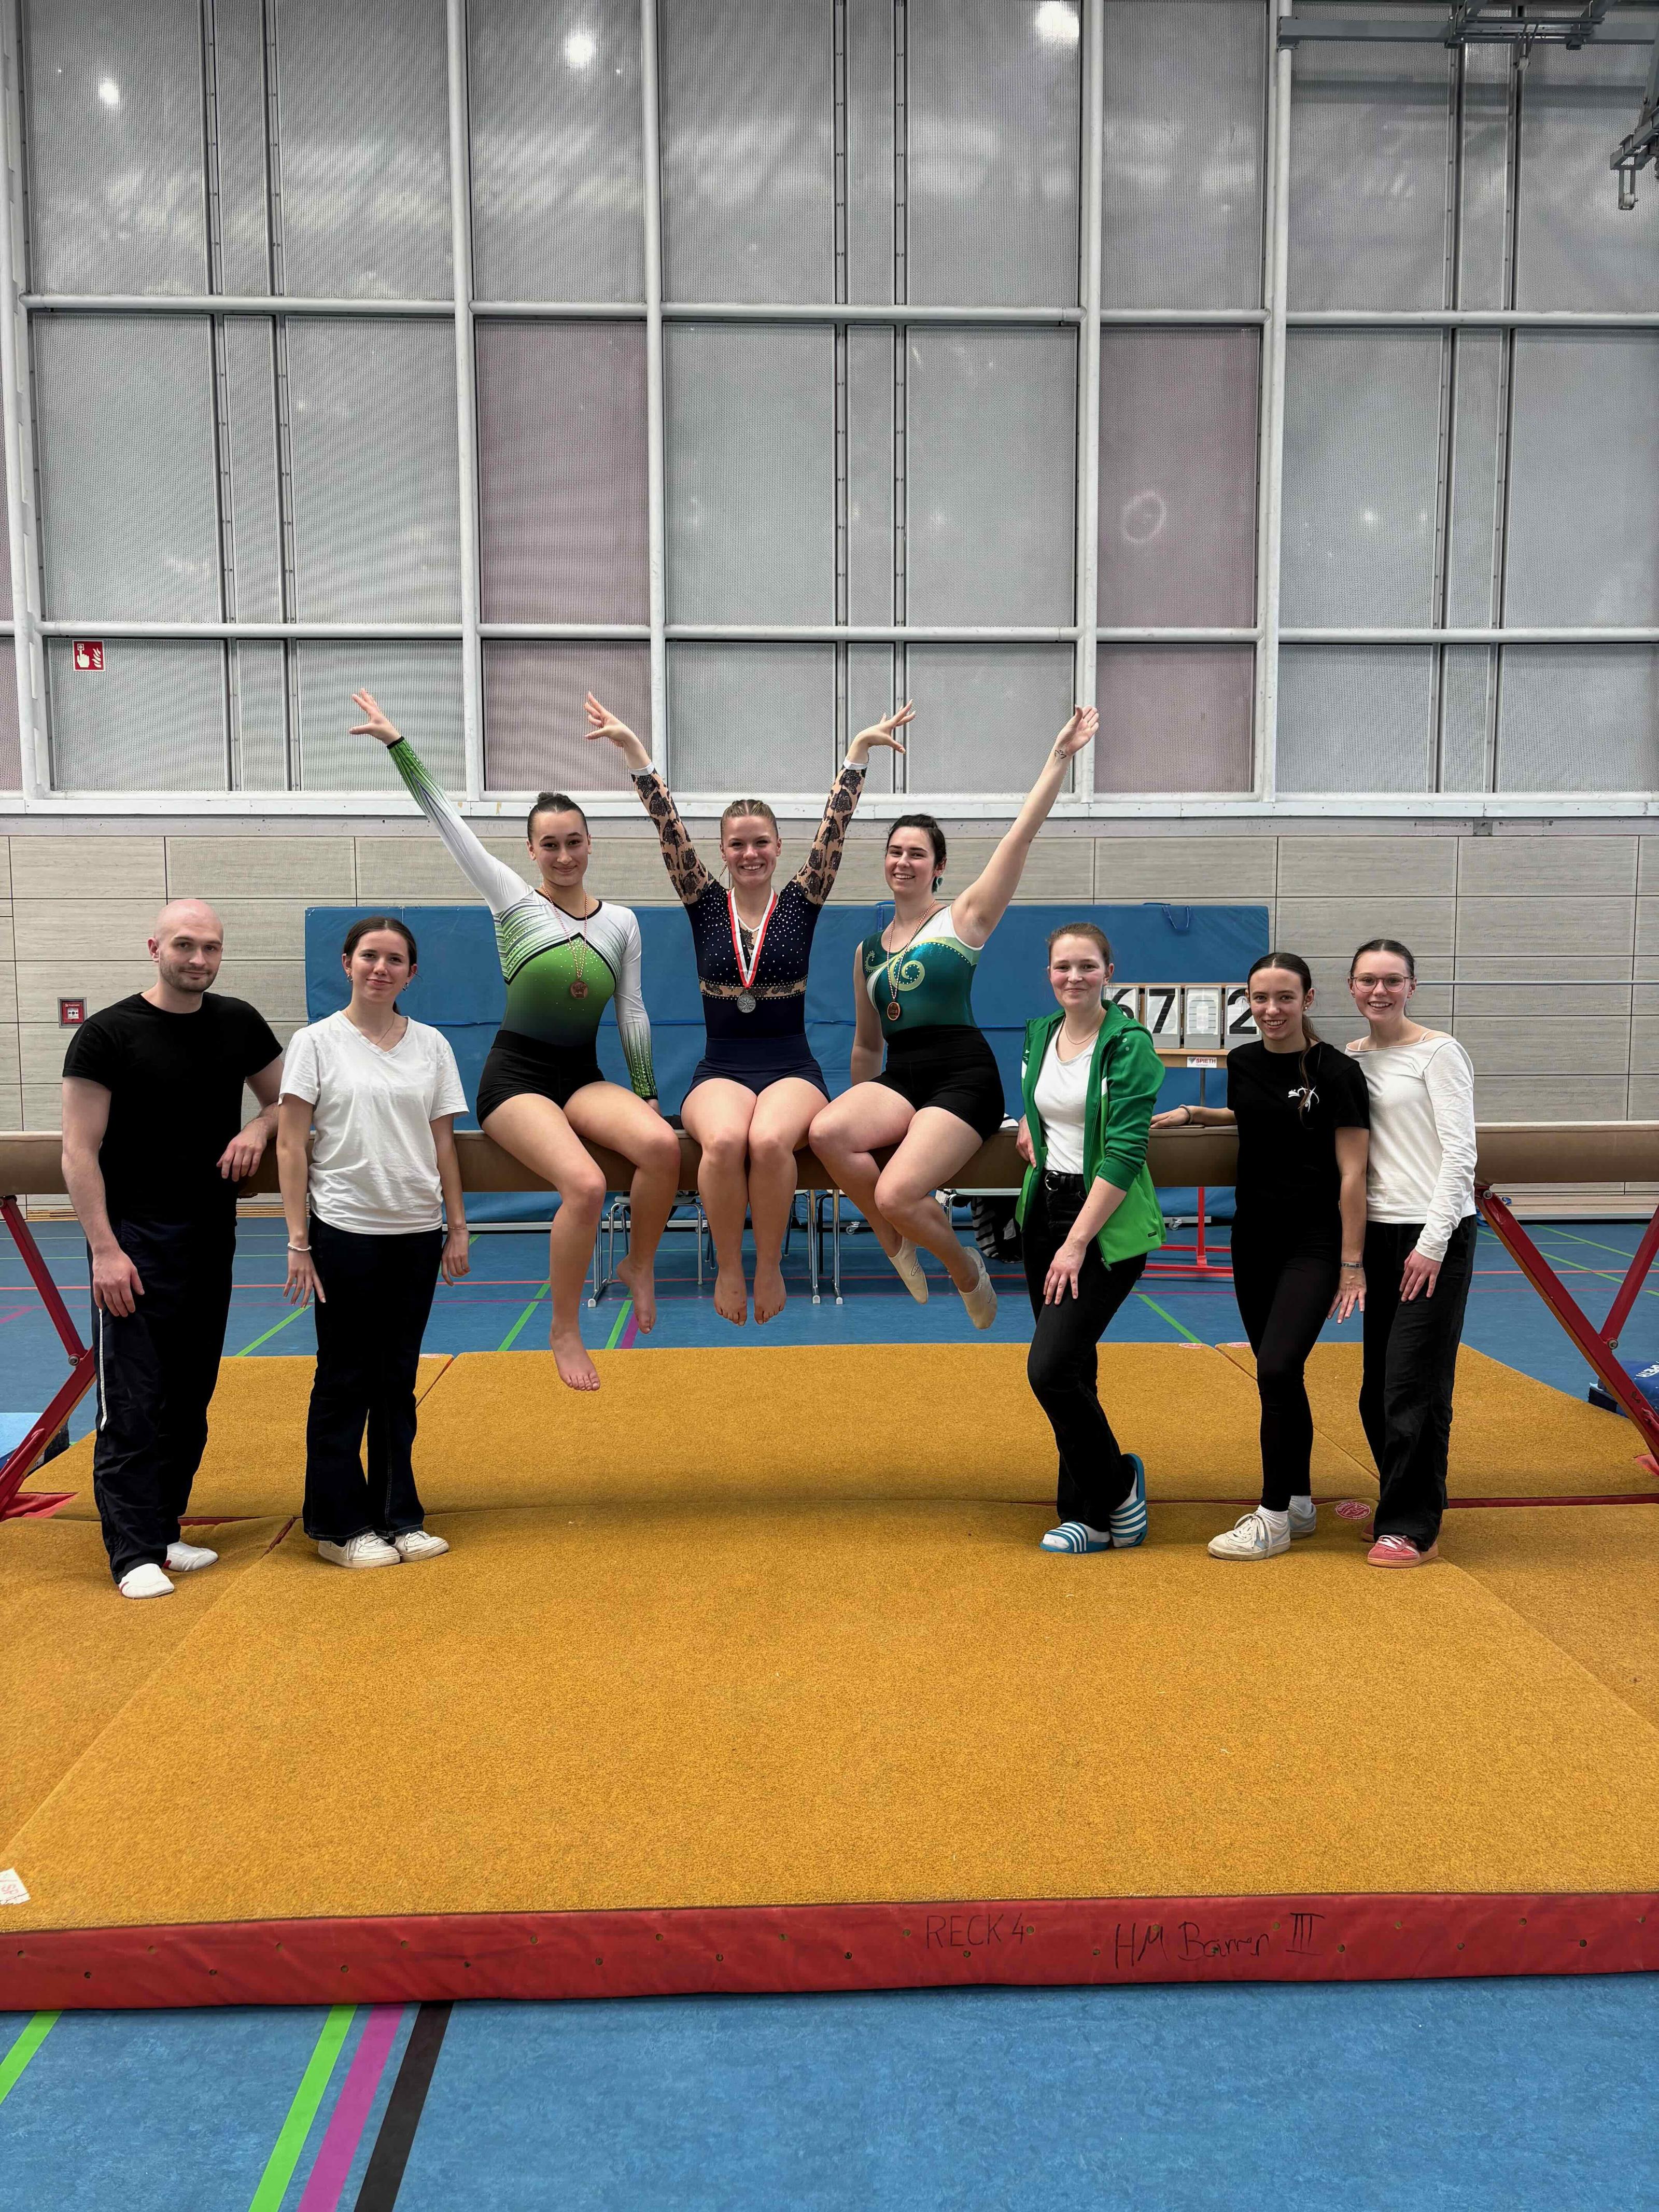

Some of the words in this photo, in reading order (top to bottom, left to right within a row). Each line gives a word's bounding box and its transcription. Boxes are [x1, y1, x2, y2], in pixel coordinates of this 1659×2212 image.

[927, 1913, 1004, 1949] RECK
[1011, 1912, 1024, 1944] 4
[1115, 1923, 1168, 1969] HM
[1177, 1921, 1269, 1961] Barren
[1286, 1912, 1325, 1956] III
